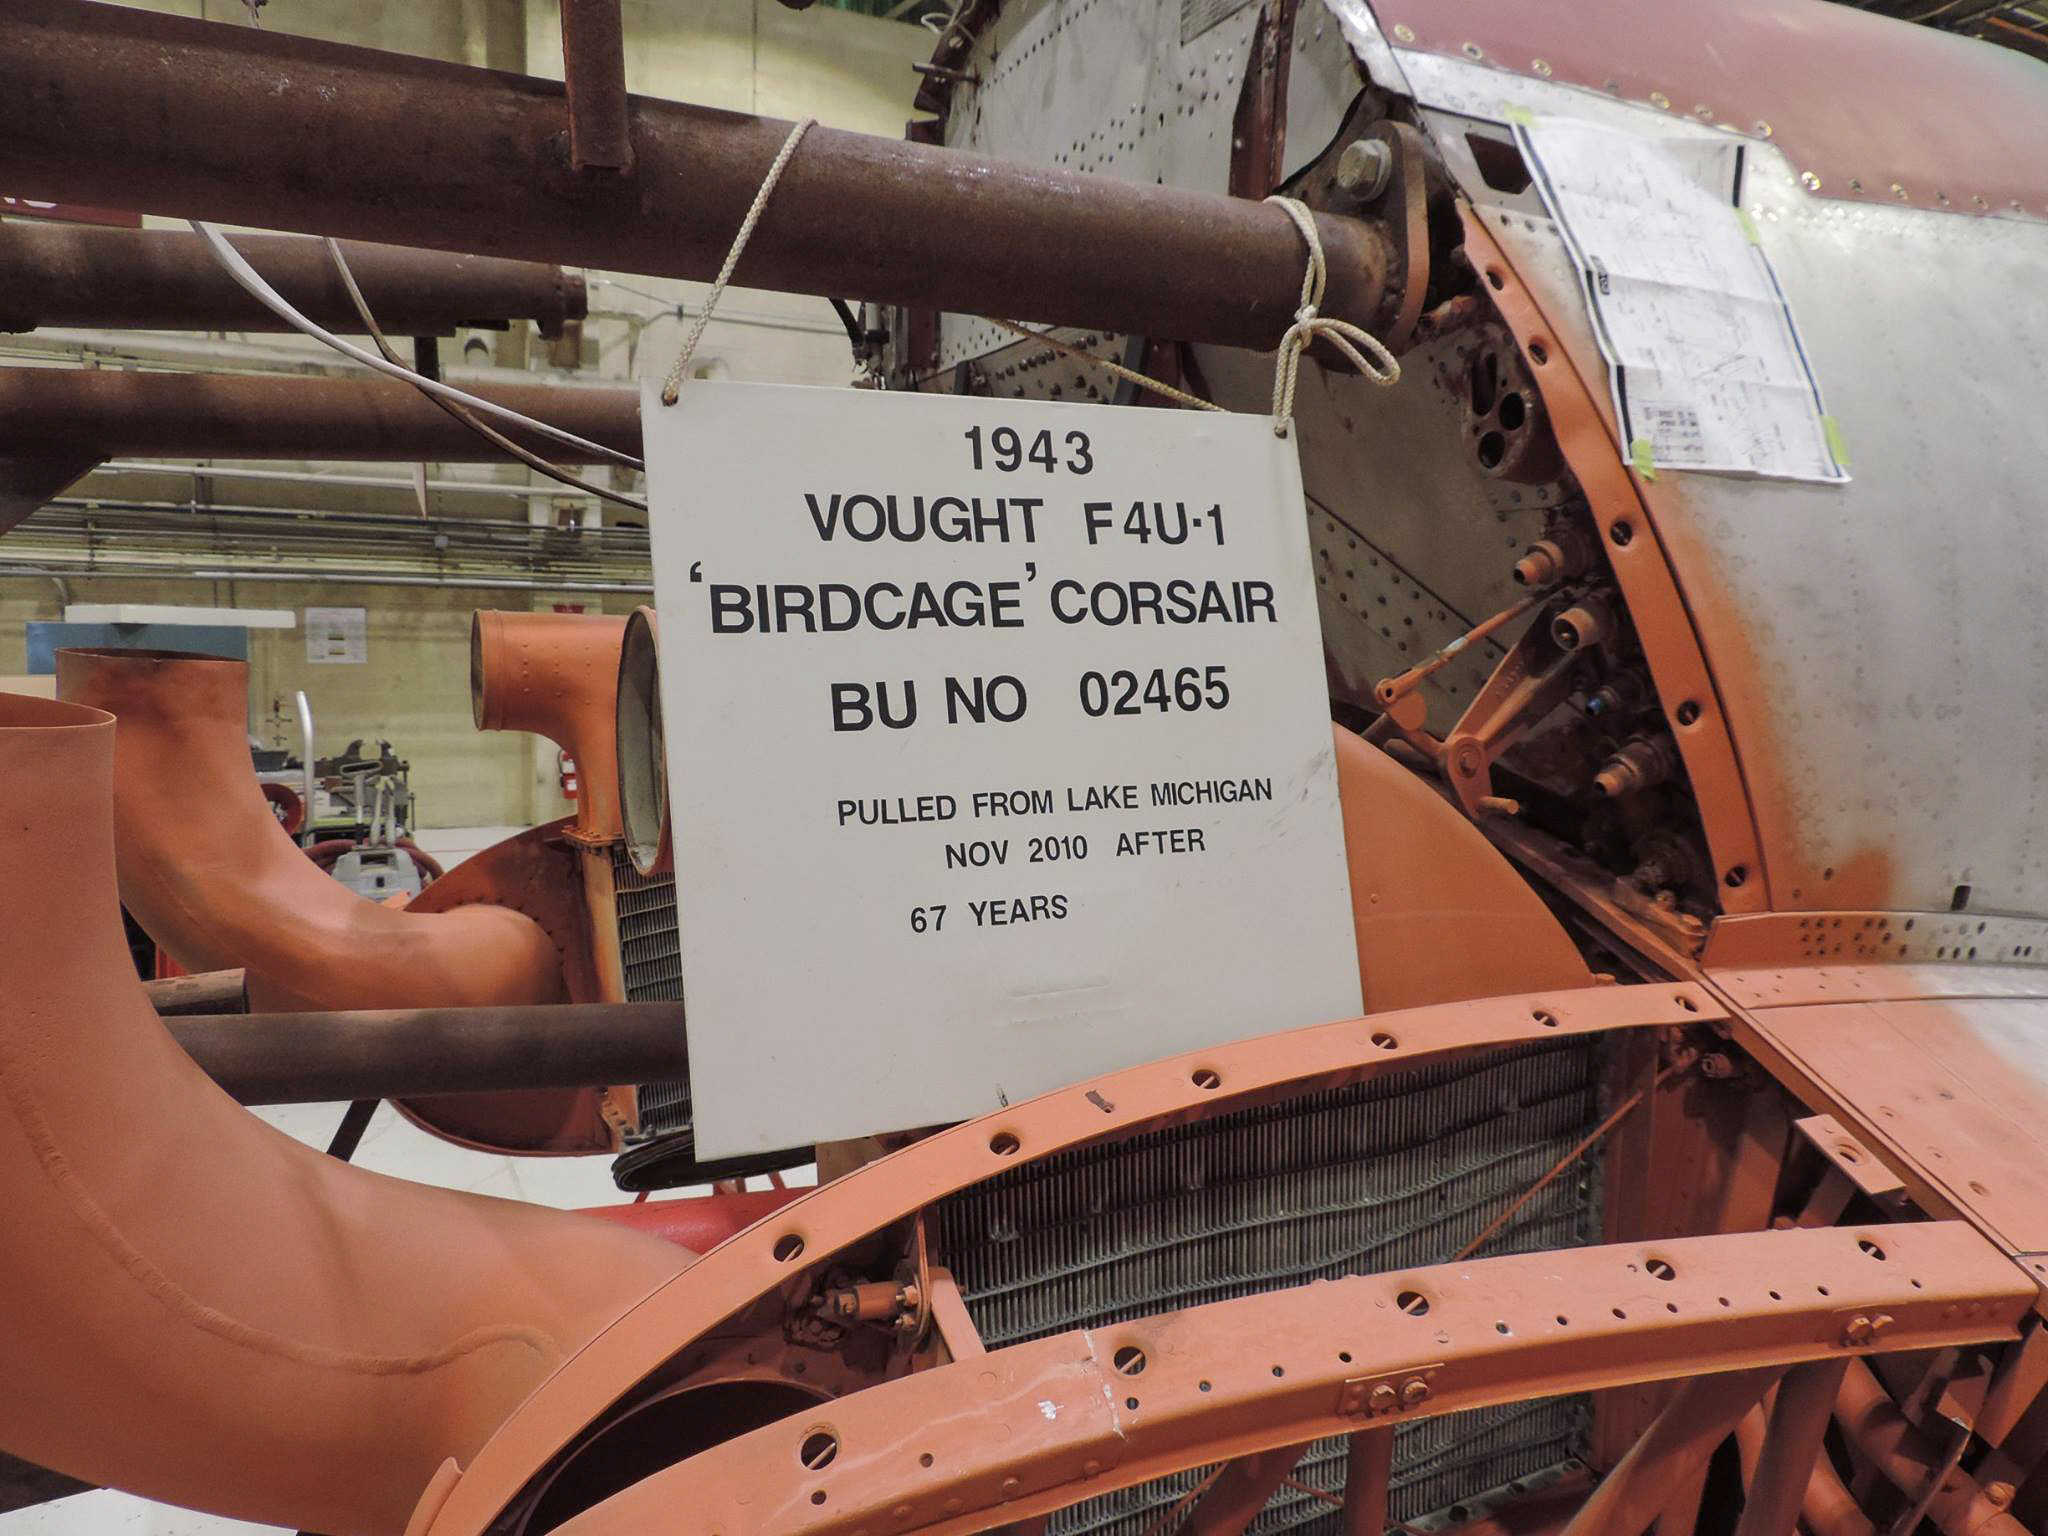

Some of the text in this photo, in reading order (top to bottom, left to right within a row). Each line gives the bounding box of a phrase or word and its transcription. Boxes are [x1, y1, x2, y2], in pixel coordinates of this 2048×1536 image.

[965, 425, 1094, 475] 1943
[804, 494, 1043, 544] VOUGHT
[1051, 579, 1278, 625] CORSAIR
[831, 665, 1230, 732] BU NO 02465
[838, 778, 1273, 826] PULLED FROM LAKE MICHIGAN
[946, 828, 1206, 869] NOV 2010 AFTER
[911, 894, 1068, 934] 67 YEARS
